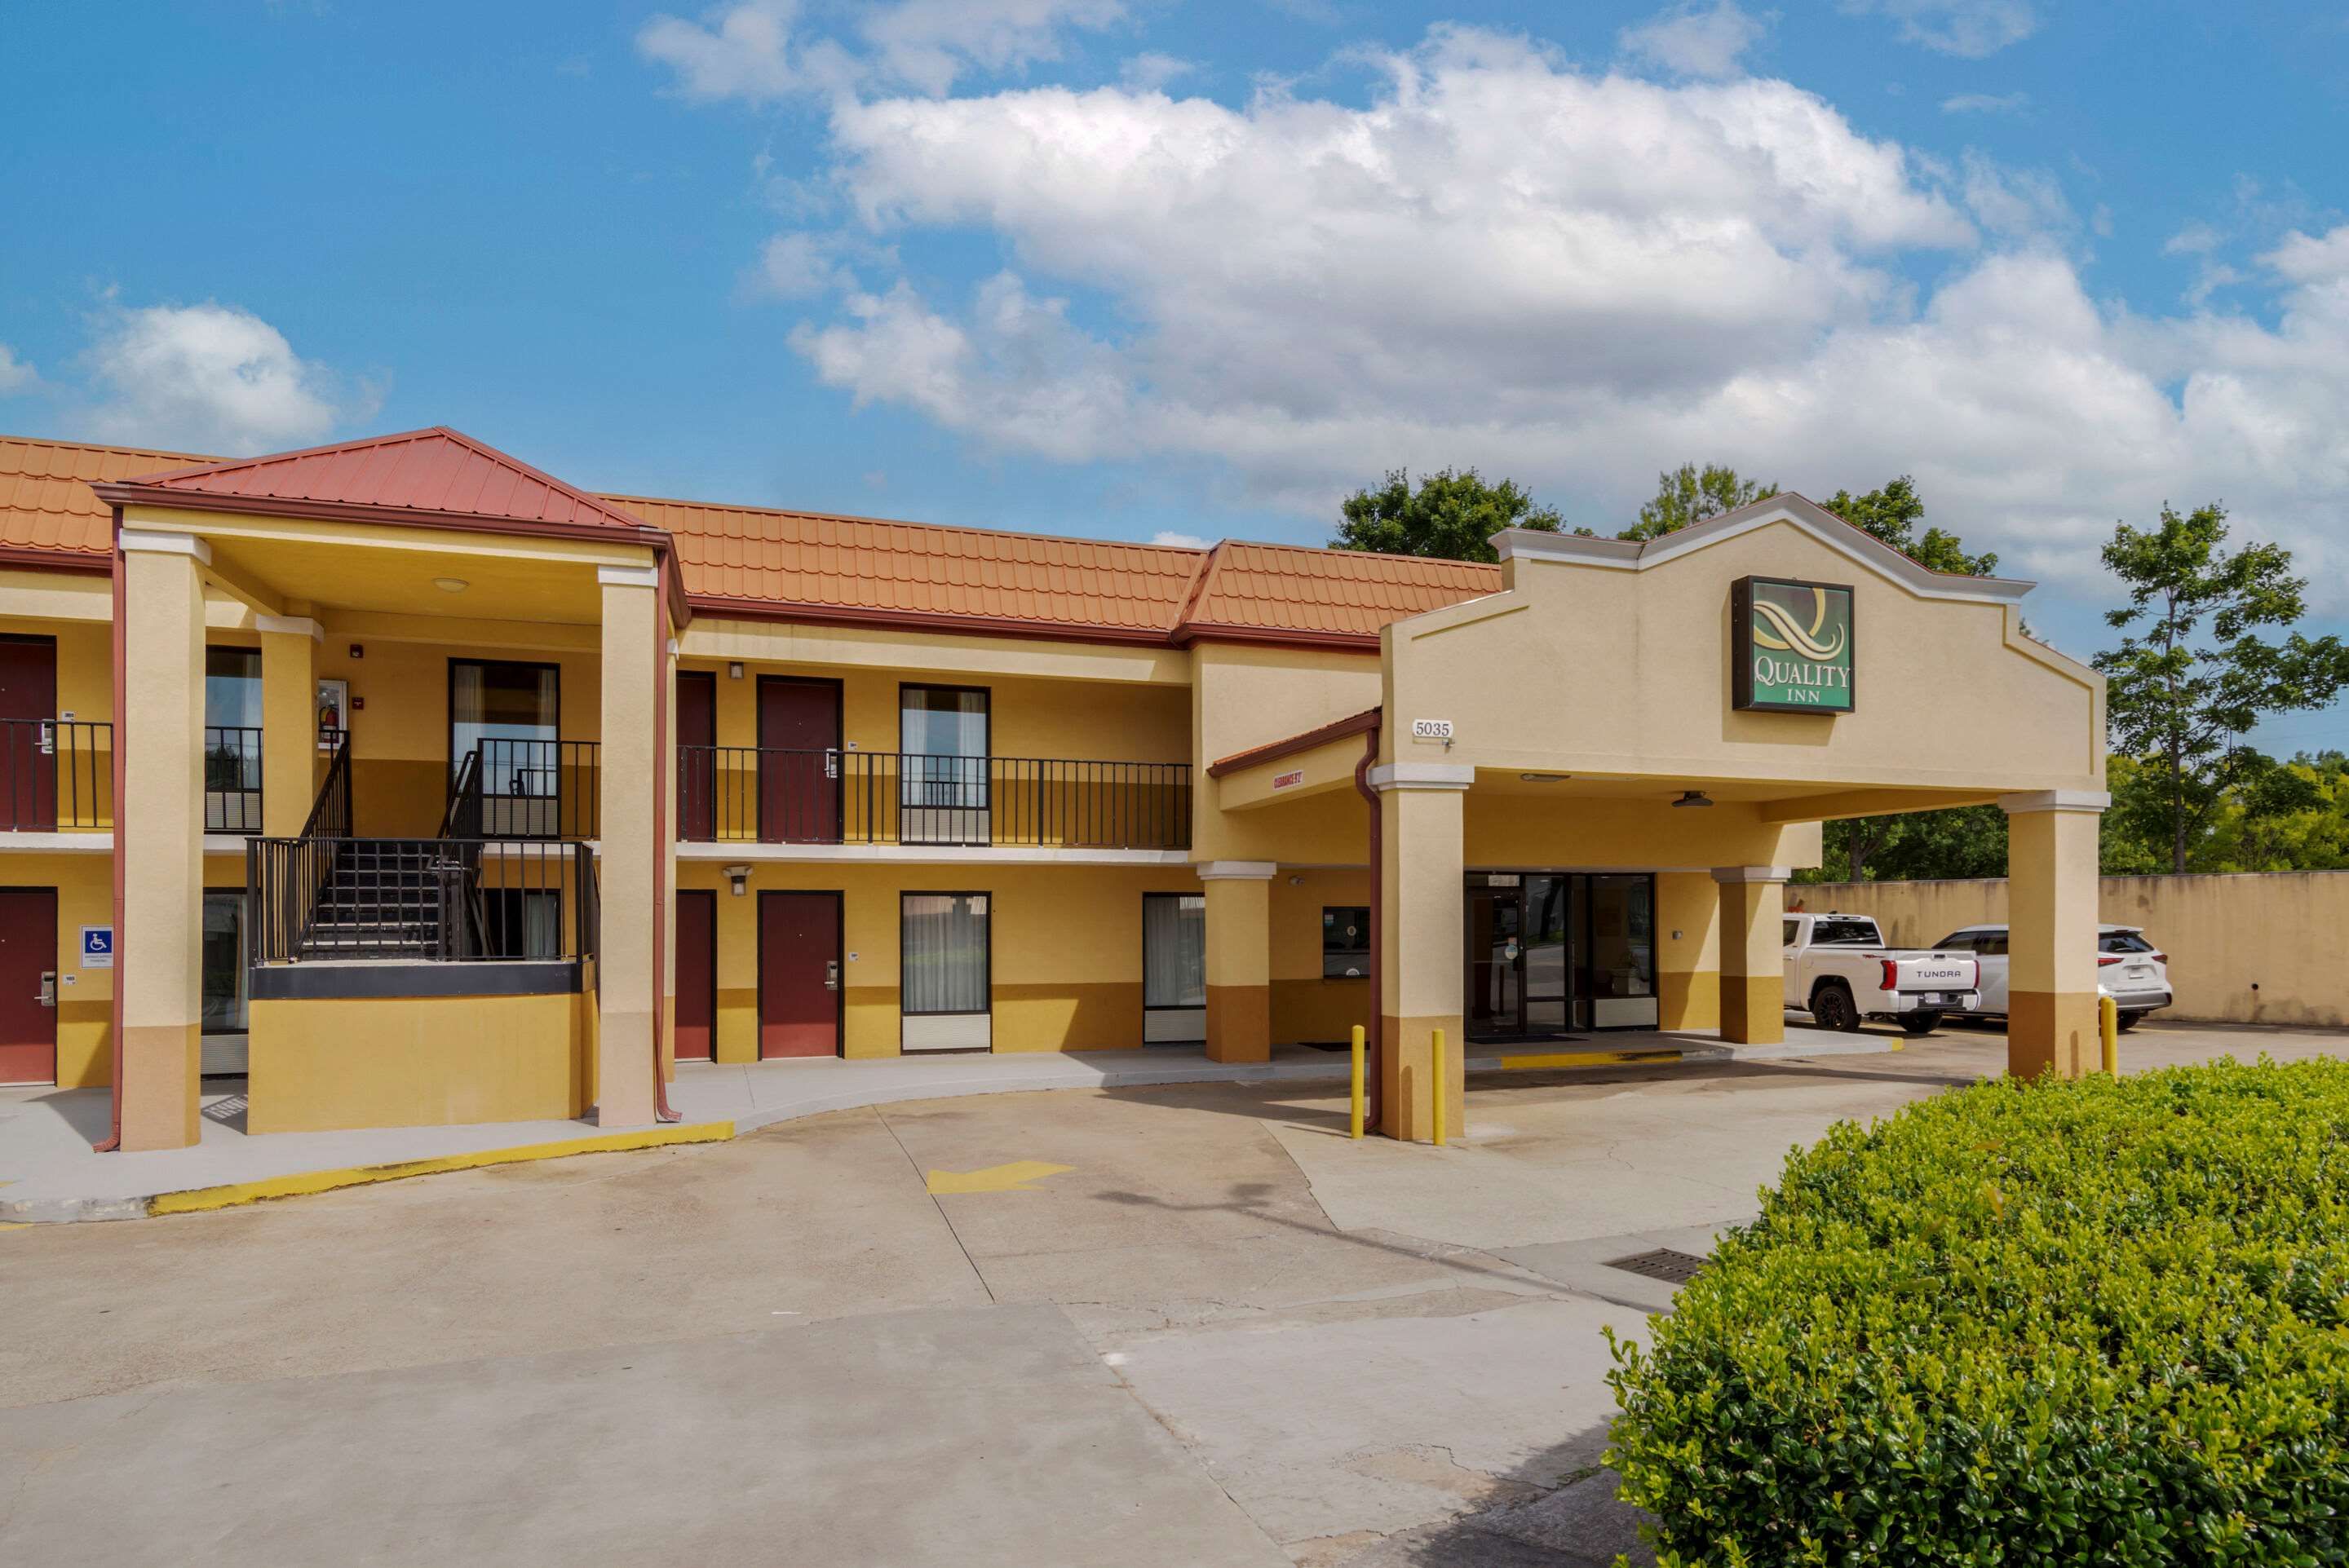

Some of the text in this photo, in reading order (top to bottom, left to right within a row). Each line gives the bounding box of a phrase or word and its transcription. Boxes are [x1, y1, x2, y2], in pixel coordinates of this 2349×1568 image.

[1754, 656, 1850, 688] QUALITY
[1787, 689, 1820, 703] INN
[1416, 722, 1449, 736] 5035
[1917, 970, 1962, 978] TUNDRA
